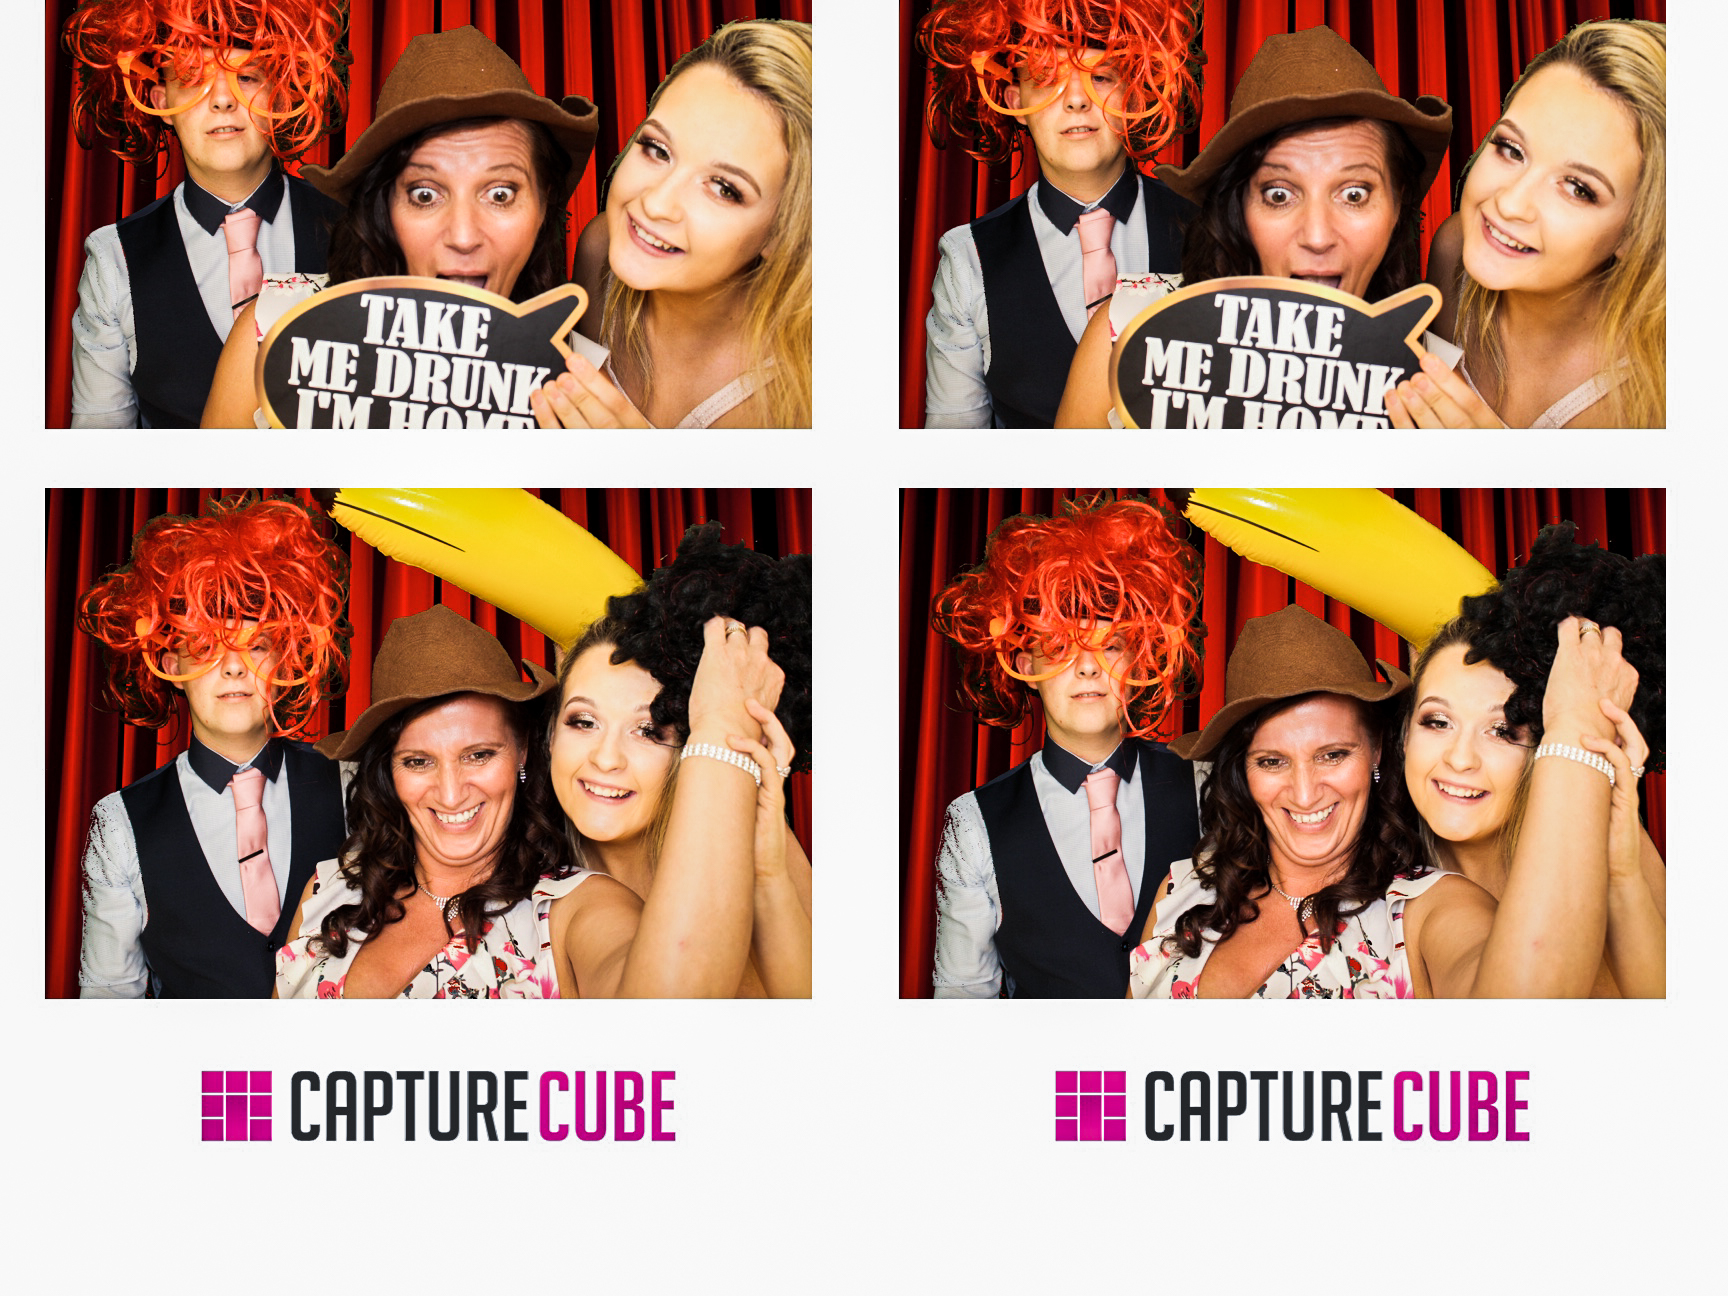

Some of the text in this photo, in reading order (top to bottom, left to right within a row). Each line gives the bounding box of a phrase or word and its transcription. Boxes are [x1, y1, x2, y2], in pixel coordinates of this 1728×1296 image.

[360, 293, 492, 358] TAKE
[1214, 293, 1346, 358] TAKE
[287, 336, 551, 416] ME DRUNK
[296, 388, 375, 429] I'M
[1141, 336, 1405, 416] ME DRUNK
[1150, 388, 1229, 429] I'M
